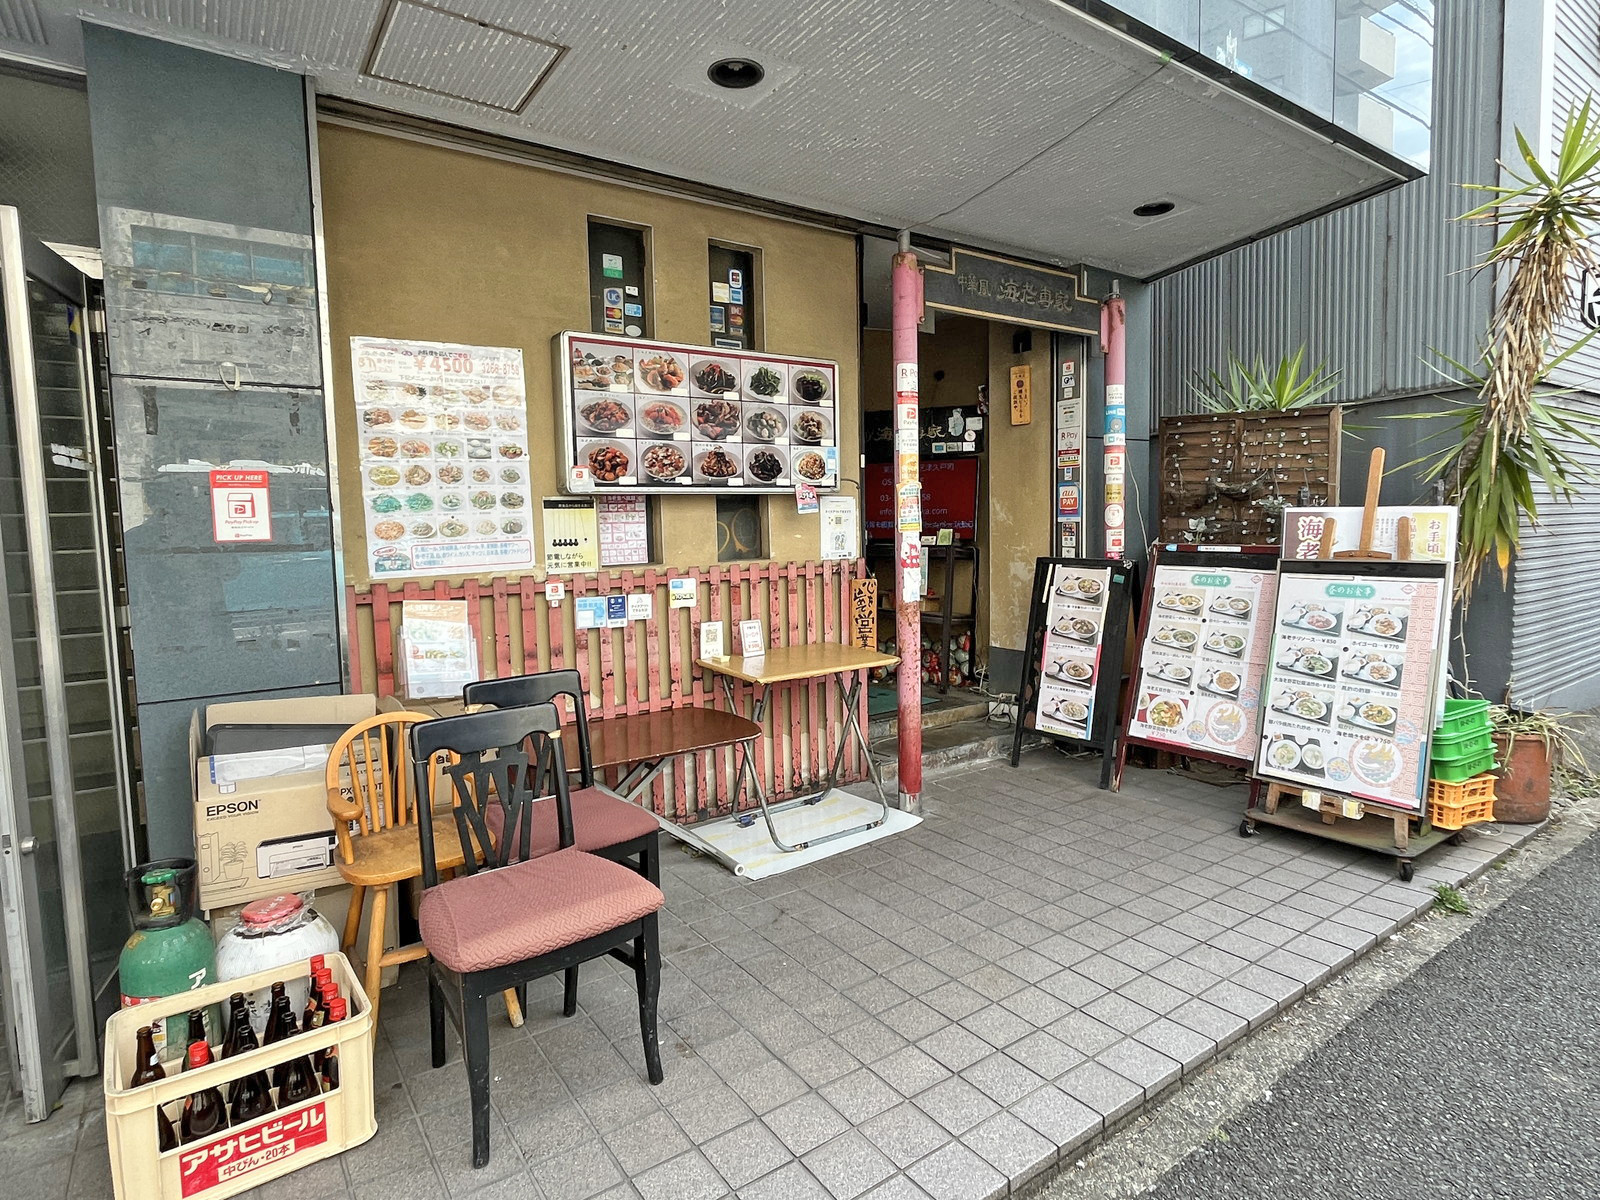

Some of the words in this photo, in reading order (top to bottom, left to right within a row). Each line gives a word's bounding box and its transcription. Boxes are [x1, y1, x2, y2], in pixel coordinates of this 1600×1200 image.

[413, 356, 474, 374] ¥4500
[1066, 432, 1078, 440] Pay
[1062, 490, 1075, 498] au
[1062, 498, 1076, 506] PAY
[1298, 518, 1324, 559] 海老
[1427, 519, 1441, 554] お手頃
[546, 552, 584, 561] 節電しながら
[1327, 585, 1372, 597] 昼のお食事
[1373, 736, 1391, 745] ¥750
[206, 799, 259, 817] EPSON
[181, 1106, 325, 1177] アサヒビール
[222, 1143, 292, 1178] 中びん・20本
